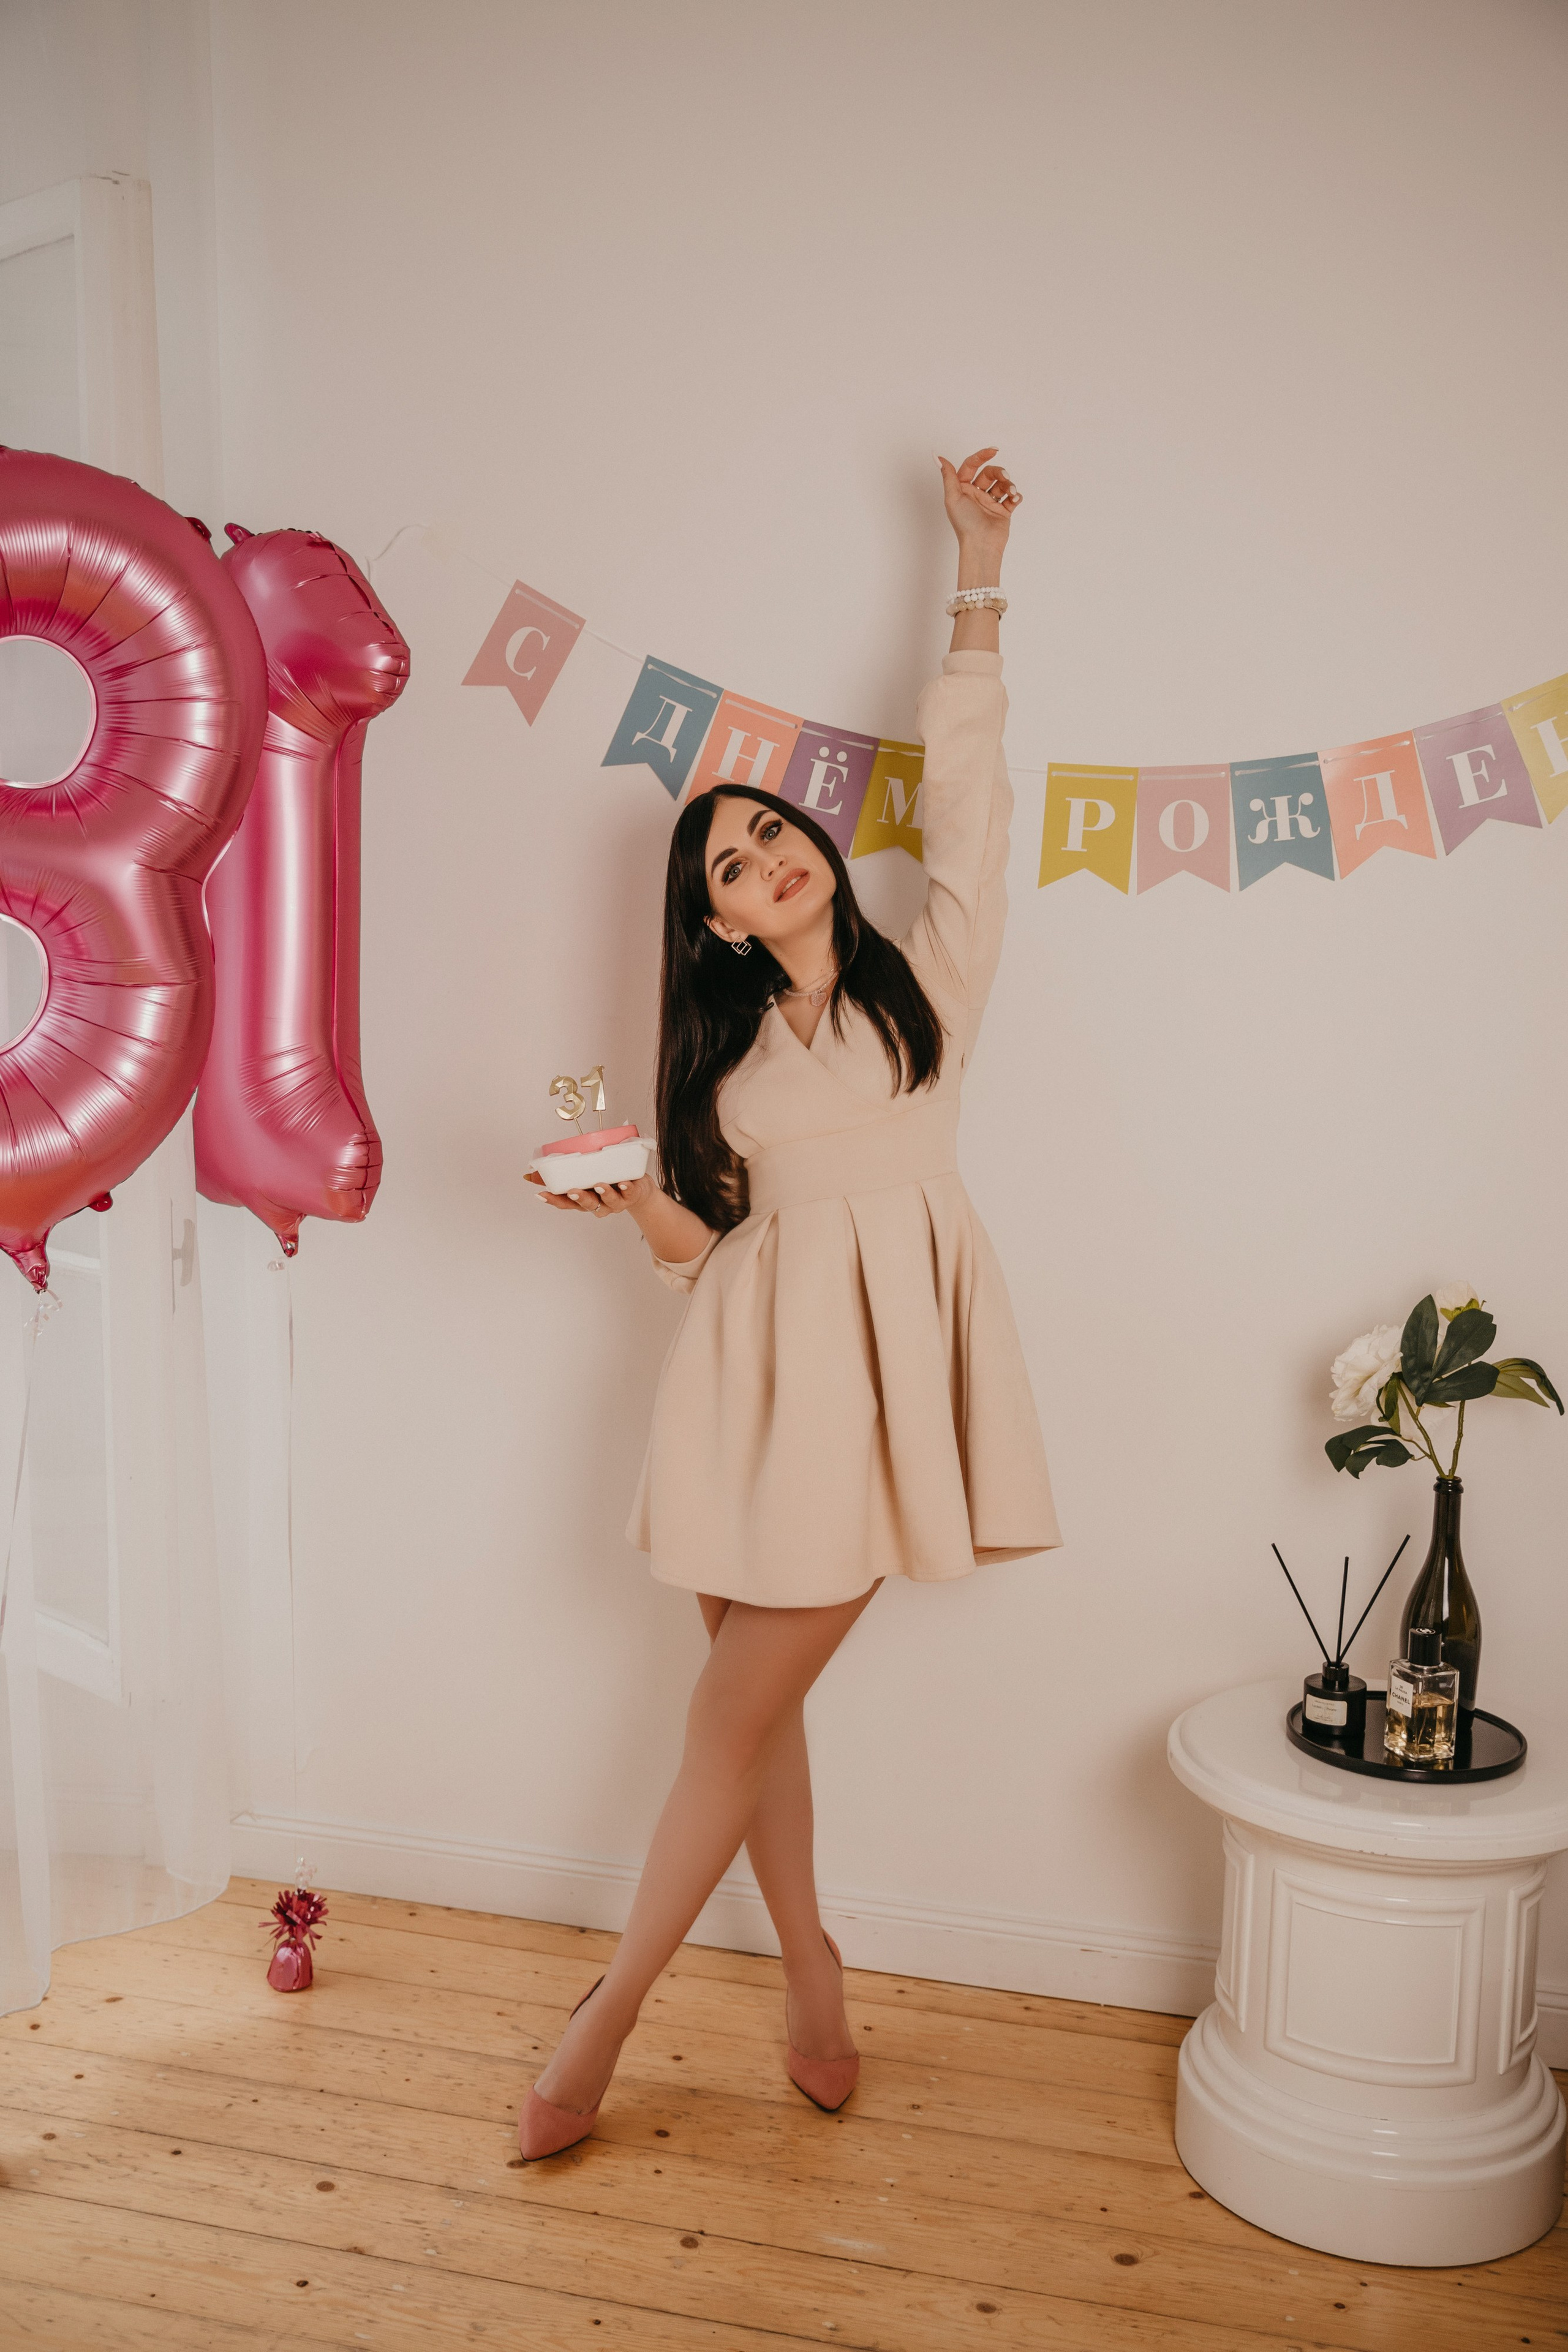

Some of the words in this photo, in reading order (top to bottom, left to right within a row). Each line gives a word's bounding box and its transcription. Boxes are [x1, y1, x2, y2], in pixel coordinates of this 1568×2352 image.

[505, 626, 551, 681] С
[631, 695, 924, 830] ДНЁМ
[549, 1065, 606, 1120] 31
[1392, 1692, 1411, 1705] CHANEL
